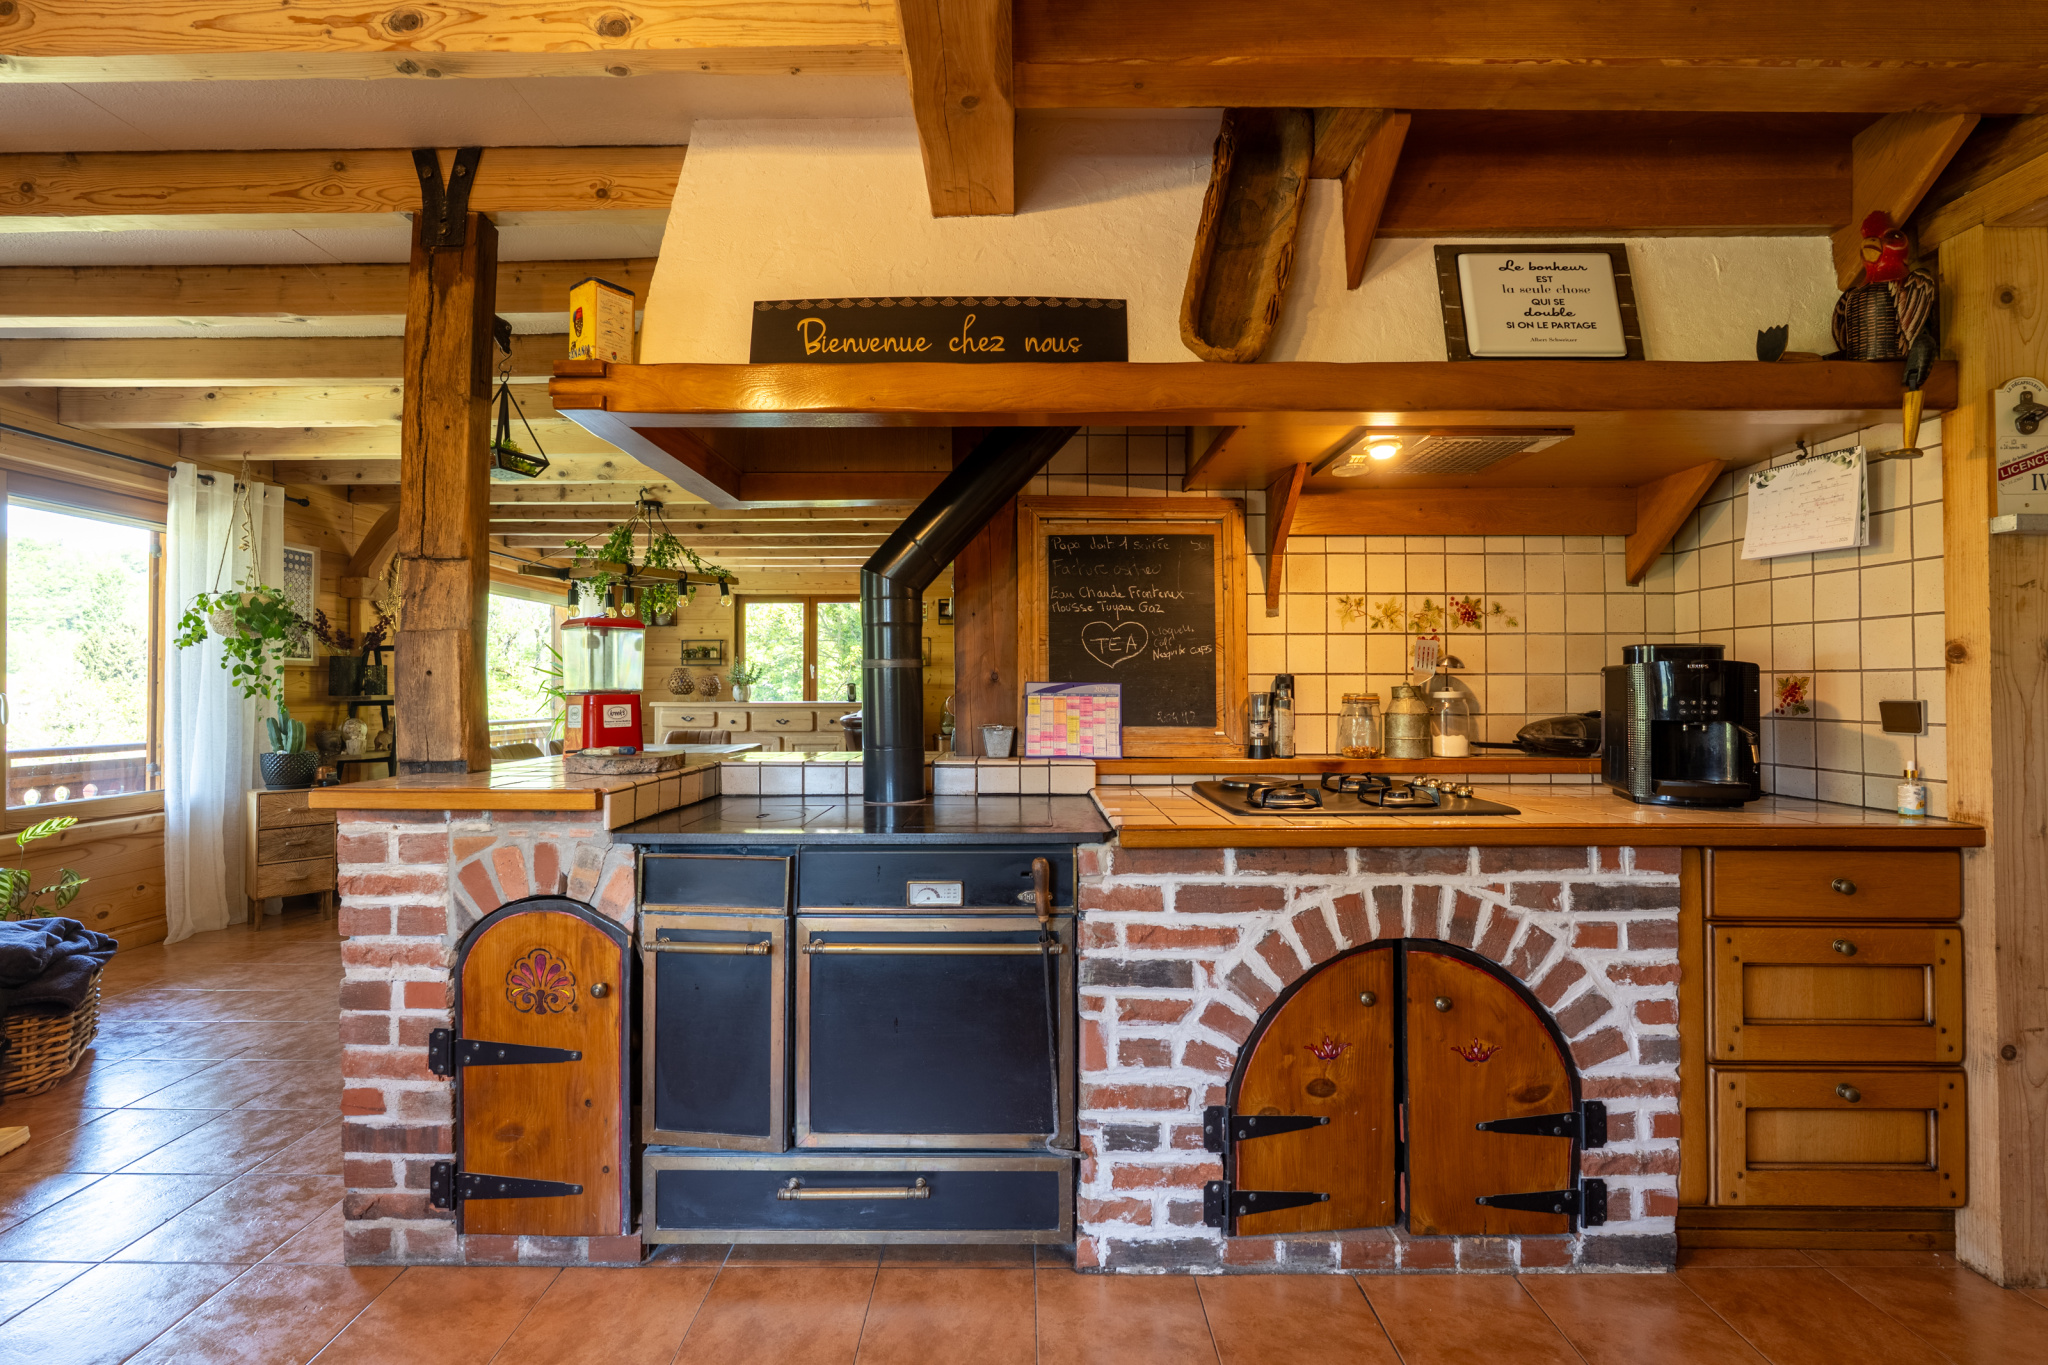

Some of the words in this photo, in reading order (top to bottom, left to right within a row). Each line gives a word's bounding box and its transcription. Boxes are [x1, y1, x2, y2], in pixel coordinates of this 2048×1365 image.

[1498, 260, 1524, 272] Le
[1529, 262, 1588, 272] bonheur
[1502, 284, 1515, 294] la
[1520, 284, 1551, 294] seule
[1556, 284, 1591, 294] chose
[1553, 298, 1565, 306] SE
[1523, 308, 1576, 317] double
[1551, 322, 1597, 330] PARTAGE
[797, 317, 932, 356] Bienvenue
[949, 314, 1006, 354] chez
[1025, 335, 1083, 354] nous
[1052, 537, 1081, 555] Papa
[1090, 536, 1115, 550] doit
[1050, 586, 1075, 599] Eau
[1079, 585, 1125, 598] Chaude
[1099, 601, 1135, 621] Tuyau
[1139, 602, 1165, 613] Gaz
[1090, 633, 1138, 654] TEA
